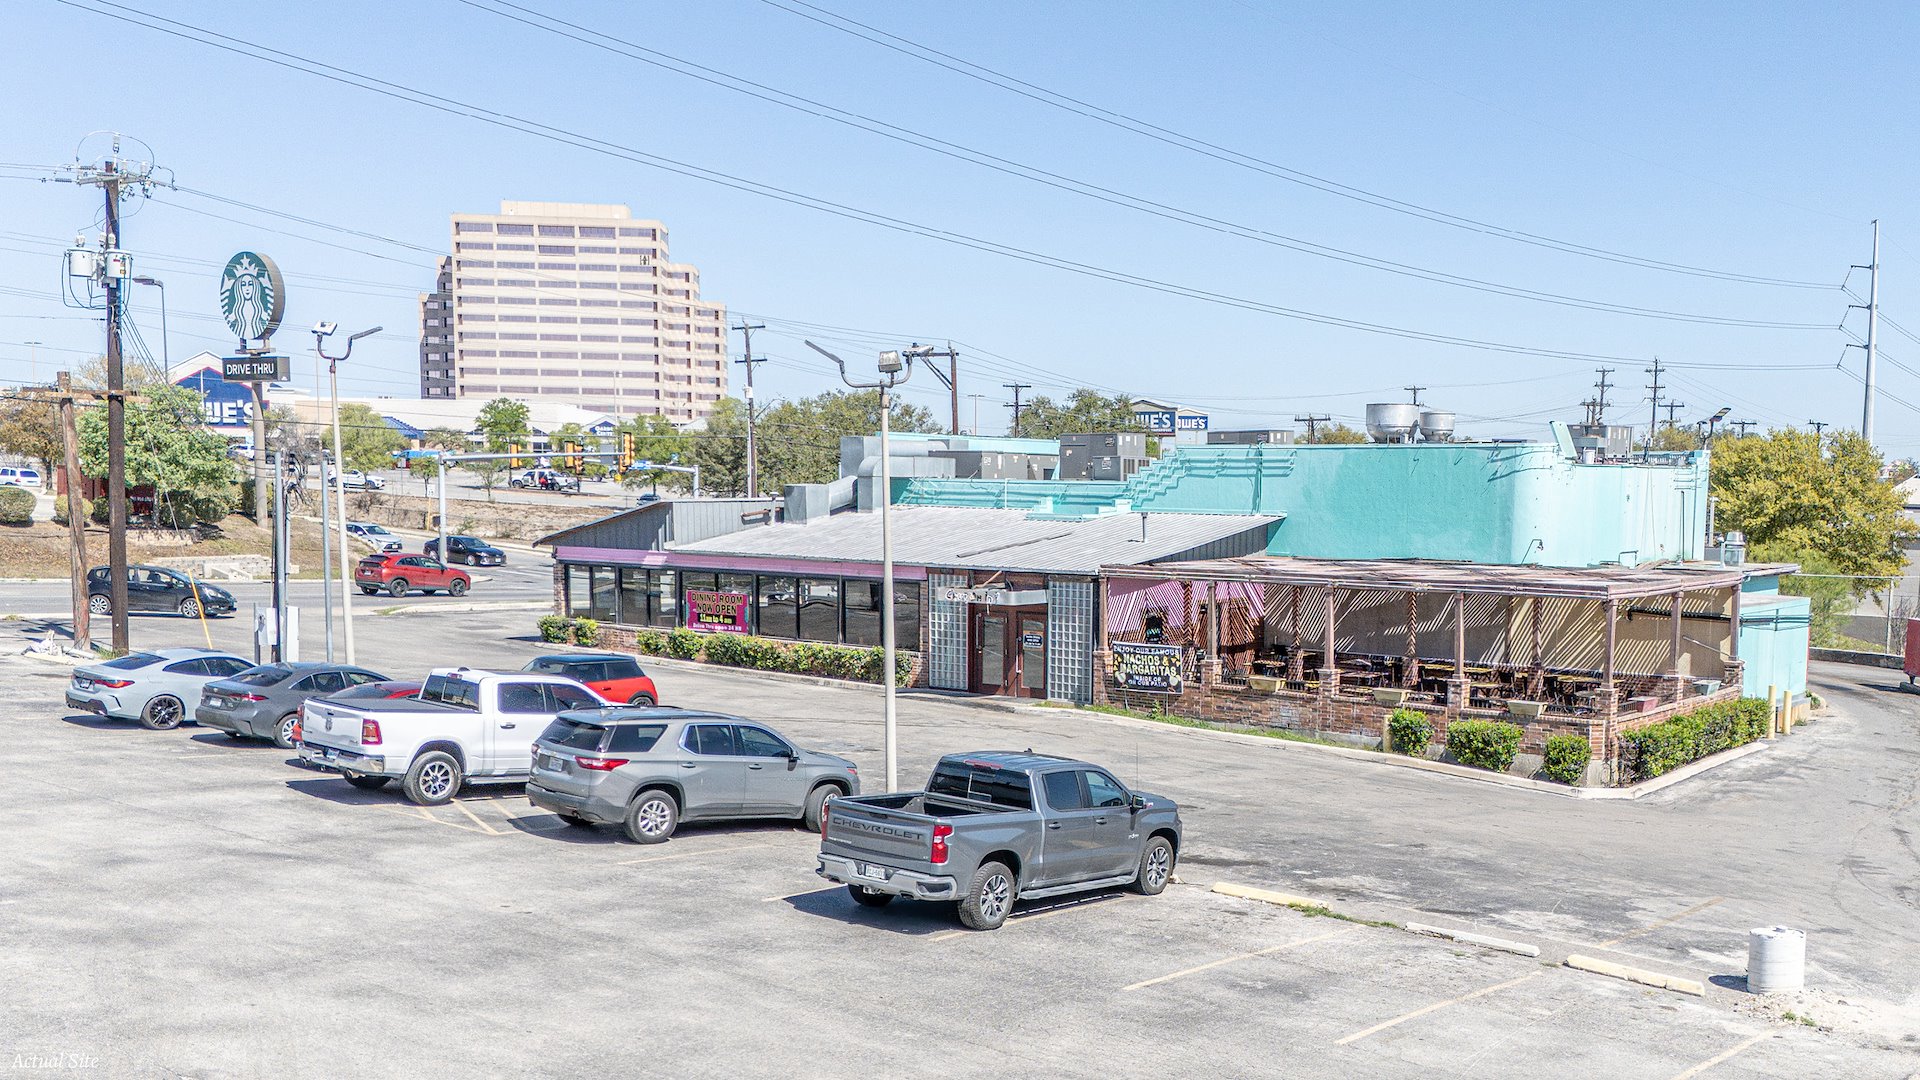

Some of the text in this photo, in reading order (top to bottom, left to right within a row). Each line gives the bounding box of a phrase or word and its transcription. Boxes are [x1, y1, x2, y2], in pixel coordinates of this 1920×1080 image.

[226, 363, 274, 375] DRIVE THRU
[206, 400, 253, 424] WE'S
[1177, 417, 1206, 429] OWE'S
[691, 593, 743, 604] DINING ROOM
[696, 603, 737, 614] NOW OPEN
[1113, 645, 1179, 656] ENJOY OUR FAMOUS
[1123, 653, 1170, 666] NACHOS &
[1120, 662, 1177, 676] MARGARITAS
[833, 817, 924, 840] CHEVROLET
